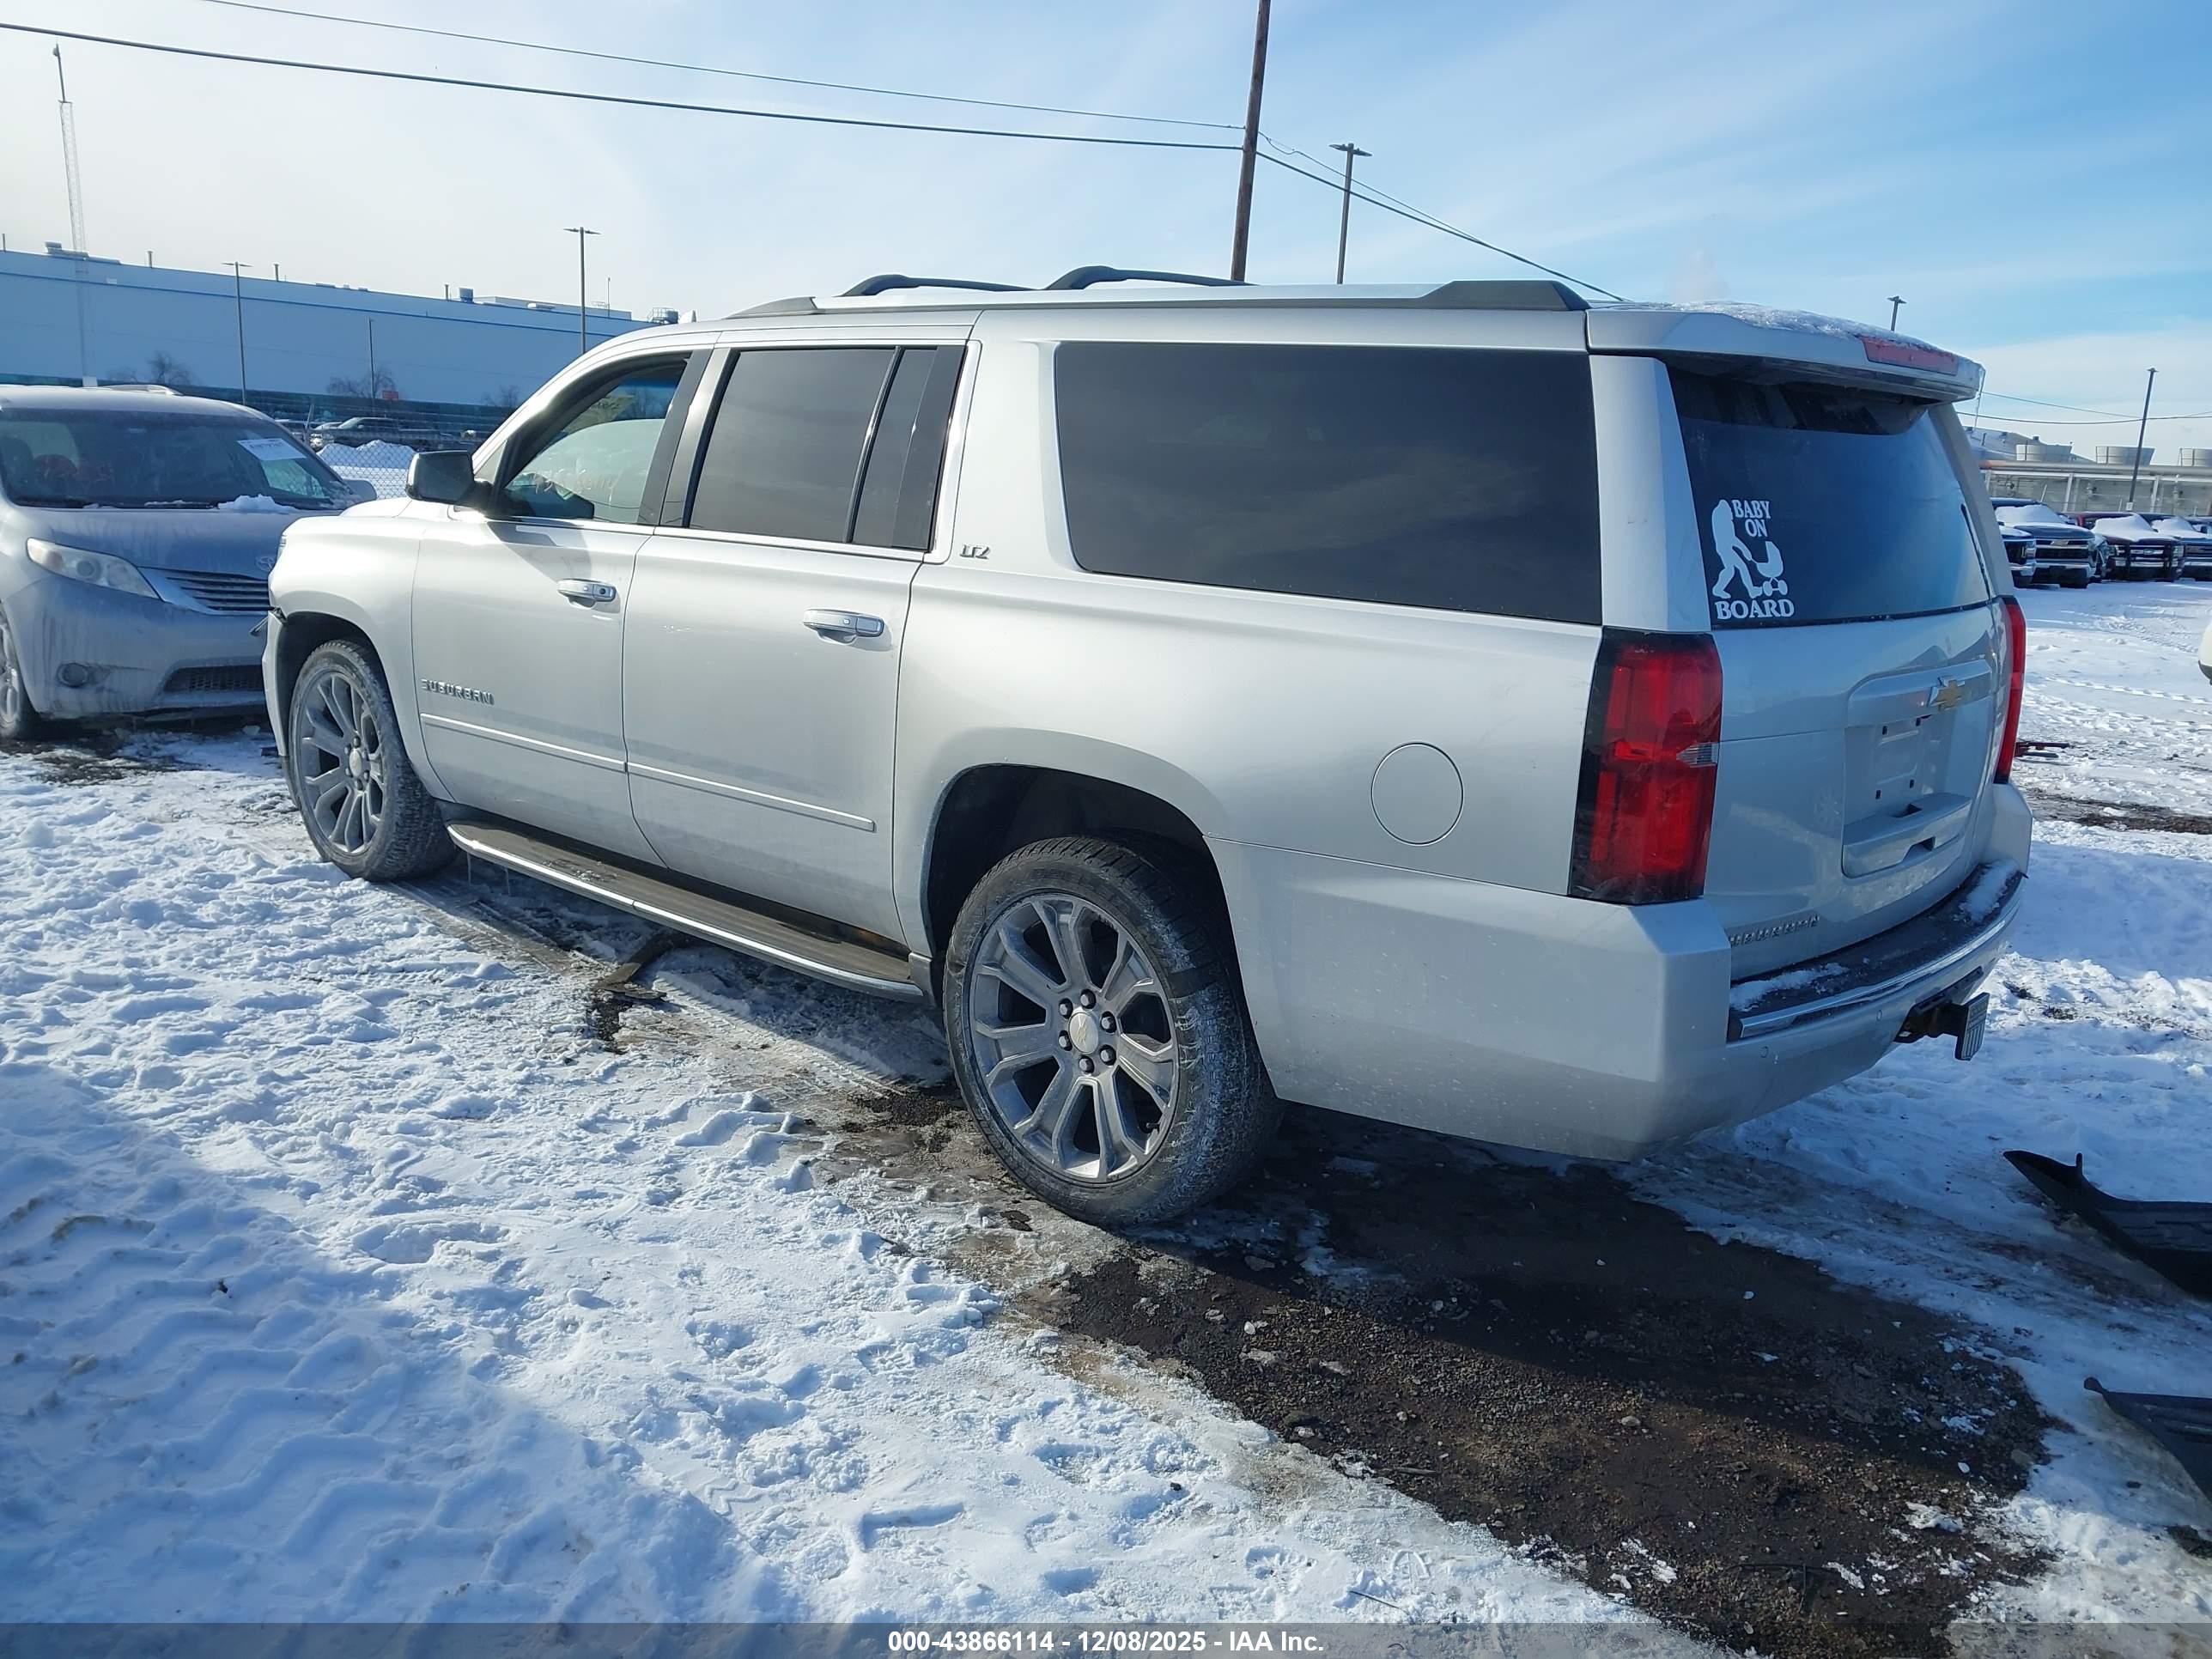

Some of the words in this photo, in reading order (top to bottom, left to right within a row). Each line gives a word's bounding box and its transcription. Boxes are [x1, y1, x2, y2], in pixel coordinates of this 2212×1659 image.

[1732, 499, 1771, 519] BABY
[1745, 519, 1767, 537] ON
[1714, 599, 1795, 620] BOARD
